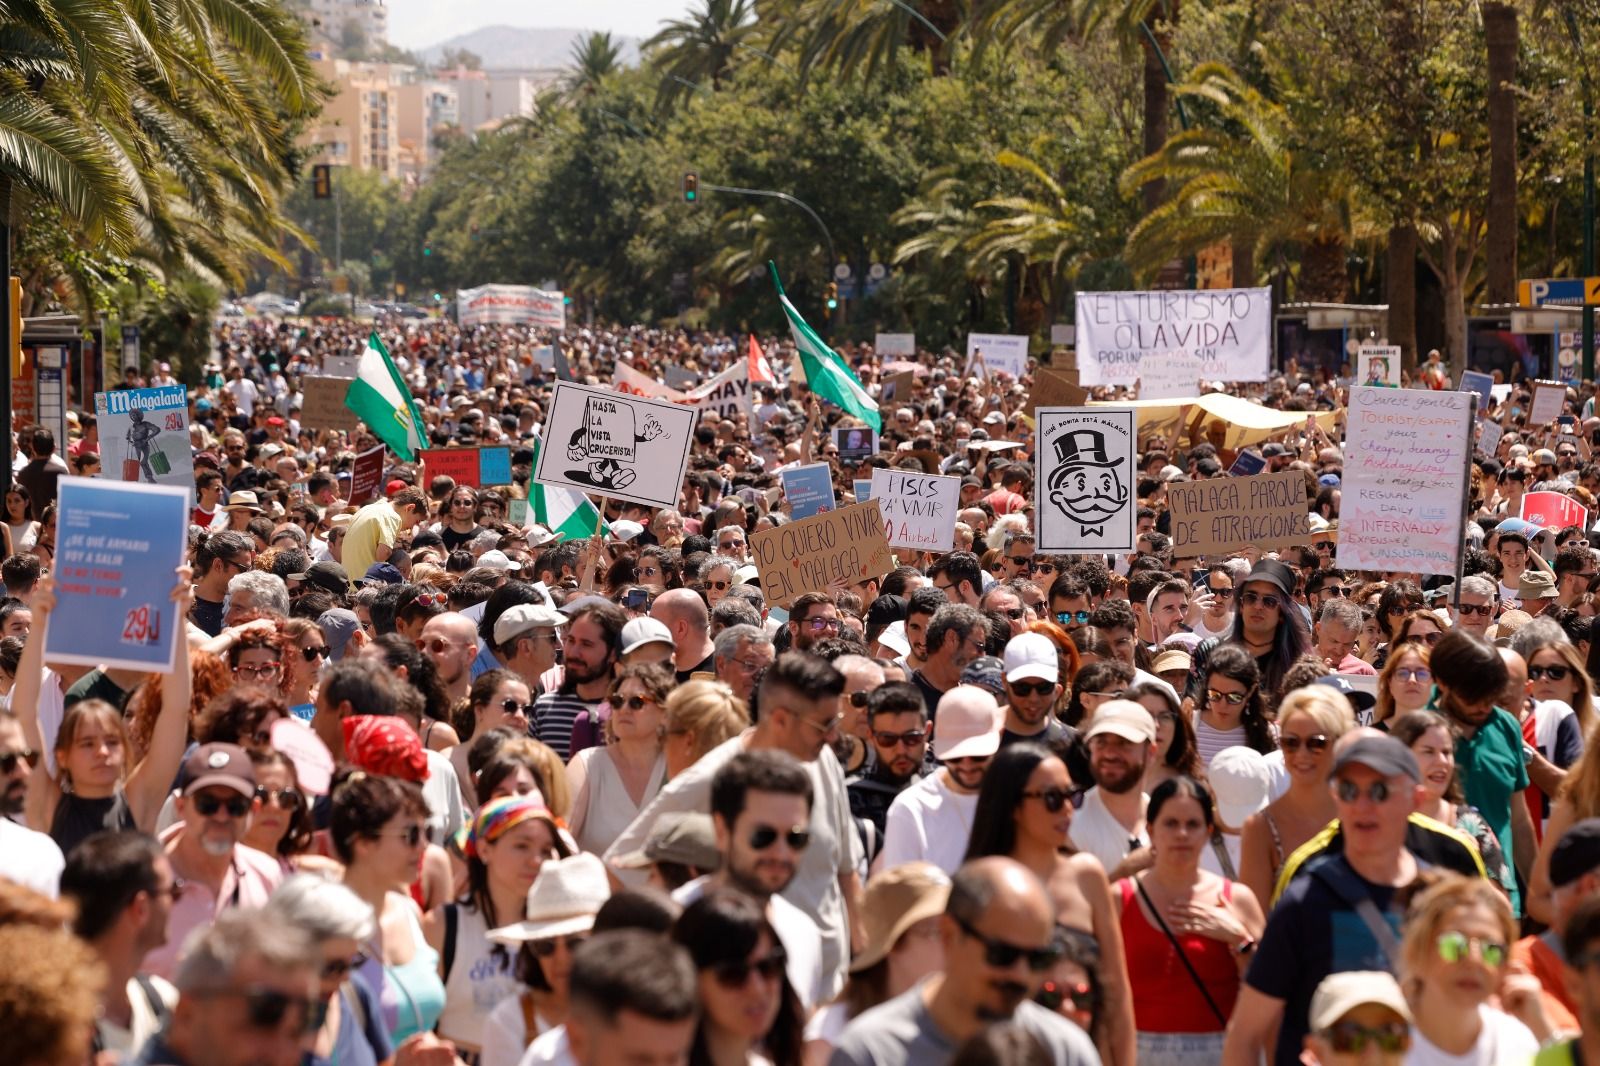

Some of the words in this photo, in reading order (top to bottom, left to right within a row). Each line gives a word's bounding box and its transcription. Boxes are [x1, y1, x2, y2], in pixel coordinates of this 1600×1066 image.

[1531, 281, 1549, 306] P
[1096, 294, 1131, 324] EL
[1133, 291, 1251, 322] TURISMO
[1137, 324, 1168, 350] LA
[1171, 321, 1239, 348] VIDA
[1098, 351, 1124, 364] POR
[592, 400, 617, 414] HASTA
[1355, 389, 1409, 407] Dearest
[1412, 396, 1463, 411] gentle
[591, 415, 603, 426] LA
[1044, 424, 1057, 437] ¡QUÉ
[1058, 419, 1079, 428] BONITA
[1101, 420, 1129, 437] MÁLAGA!
[590, 430, 611, 442] VISTA
[589, 443, 634, 457] CRUCERISTA!
[888, 475, 938, 498] PISOS
[1171, 483, 1246, 515] MÁLAGA,
[1250, 479, 1306, 509] PARQUE
[902, 498, 944, 519] VIVIR
[752, 538, 775, 568] YO
[781, 519, 836, 561] QUIERO
[842, 506, 883, 541] VIVIR
[899, 521, 937, 544] Airbnb
[1176, 520, 1200, 546] DE
[1211, 511, 1311, 543] ATRACCIONES
[1361, 520, 1442, 536] INFERNALLY
[107, 539, 149, 552] ARMARIO
[765, 567, 794, 601] EN
[124, 606, 160, 640] 29J
